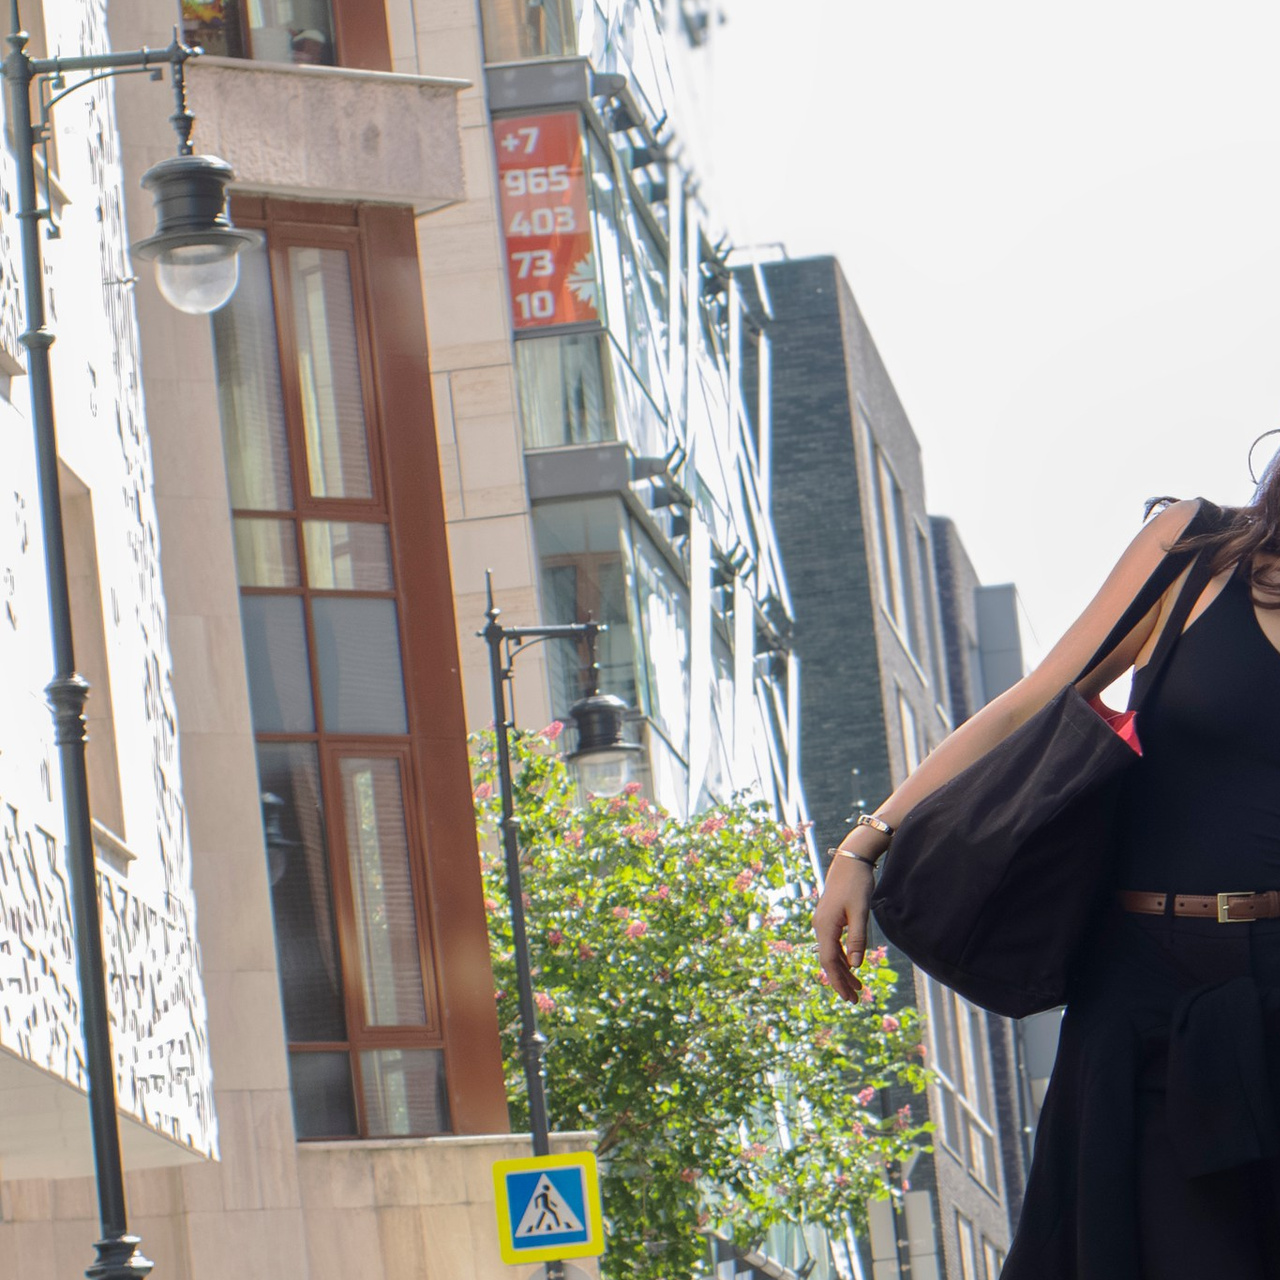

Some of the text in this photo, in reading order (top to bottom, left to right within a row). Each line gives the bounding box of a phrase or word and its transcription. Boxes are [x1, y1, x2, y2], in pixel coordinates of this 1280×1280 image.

[501, 127, 539, 154] +7
[504, 165, 570, 196] 965
[509, 206, 576, 236] 403
[512, 249, 555, 279] 73
[516, 290, 555, 319] 10
